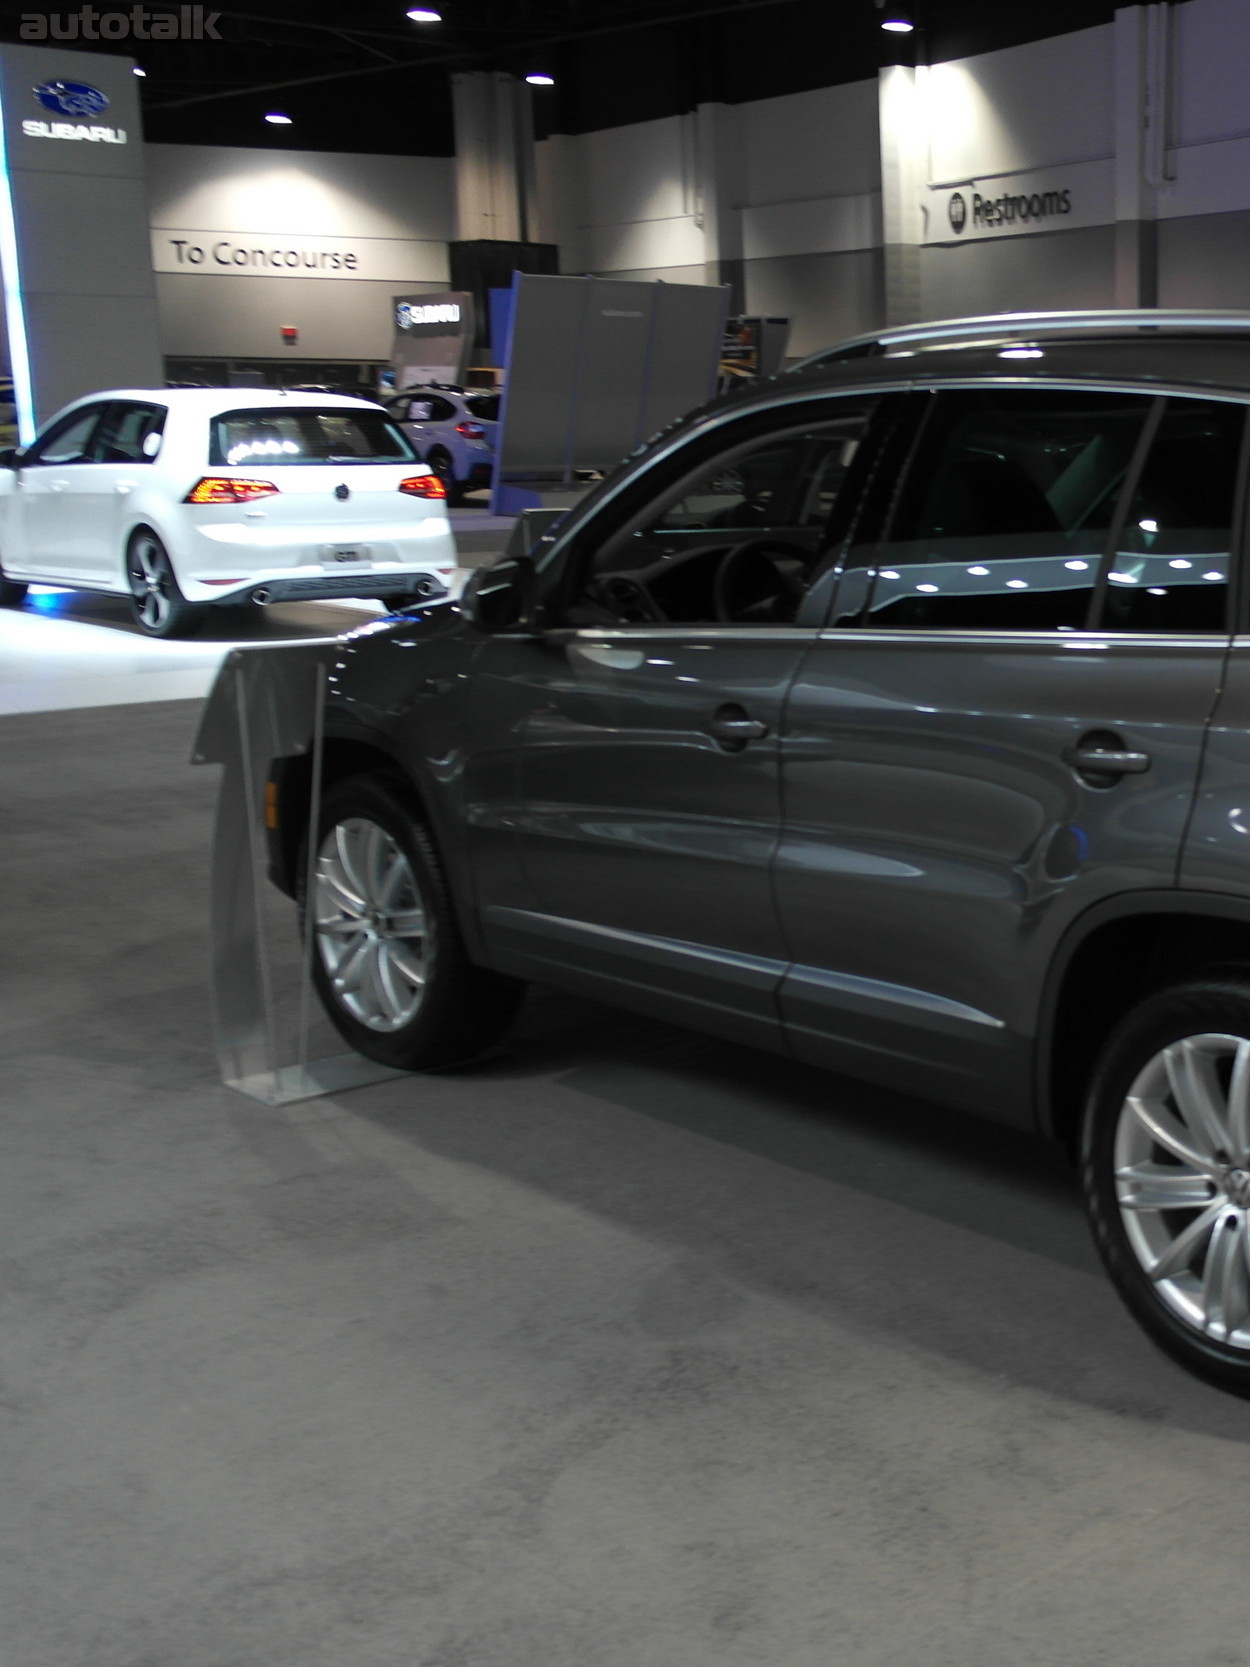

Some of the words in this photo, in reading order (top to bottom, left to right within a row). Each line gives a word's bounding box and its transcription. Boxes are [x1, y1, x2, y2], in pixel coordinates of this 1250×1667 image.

[22, 120, 127, 144] SUBARU
[972, 189, 1072, 229] Restrooms
[169, 240, 204, 265] To
[212, 242, 359, 270] Concourse
